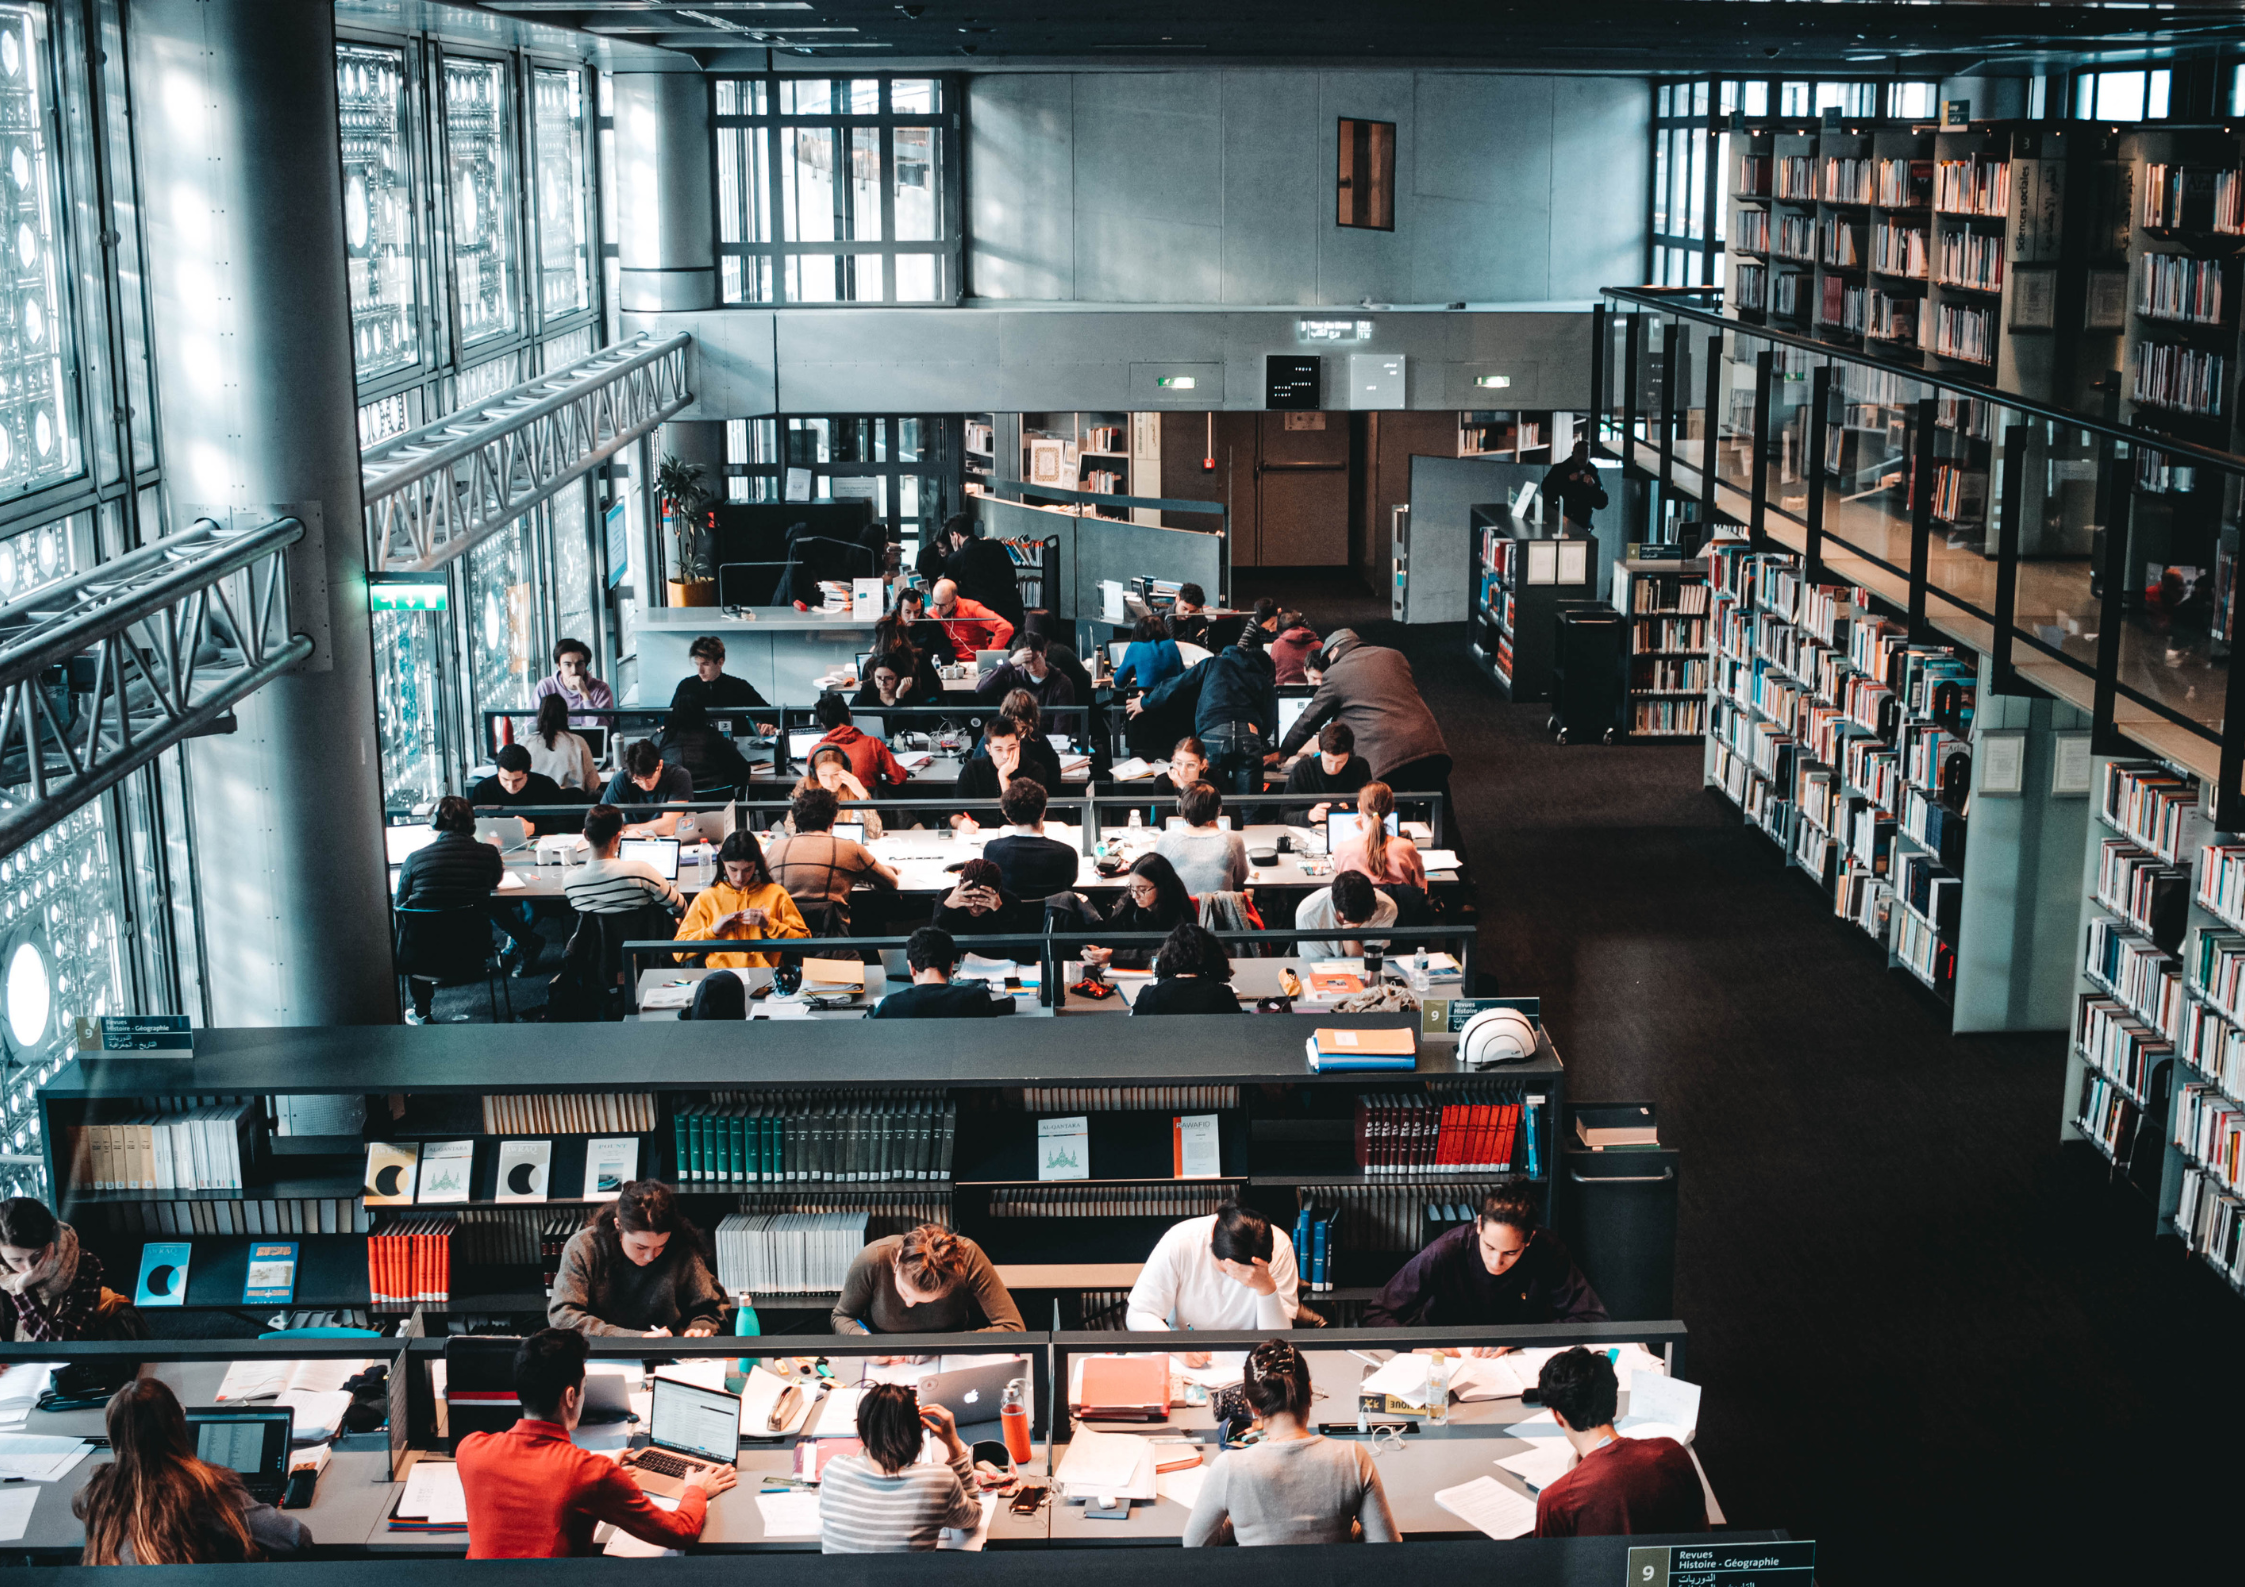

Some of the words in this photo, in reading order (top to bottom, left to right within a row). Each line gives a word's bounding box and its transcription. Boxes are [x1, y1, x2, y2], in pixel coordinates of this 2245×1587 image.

[2019, 165, 2030, 206] sociales
[2016, 208, 2027, 252] Sciences
[1431, 1010, 1440, 1021] 9
[1454, 1007, 1478, 1015] Histoire
[85, 1028, 93, 1039] 9
[135, 1025, 170, 1033] Géographie
[1042, 1122, 1081, 1131] AL-QANTARA
[428, 1145, 468, 1153] AL-QANTARA
[505, 1145, 539, 1155] AWRAQ
[1679, 1550, 1714, 1560] Revues
[1678, 1559, 1717, 1570] Histoire
[1724, 1557, 1780, 1570] Géographie
[1642, 1565, 1655, 1582] 9
